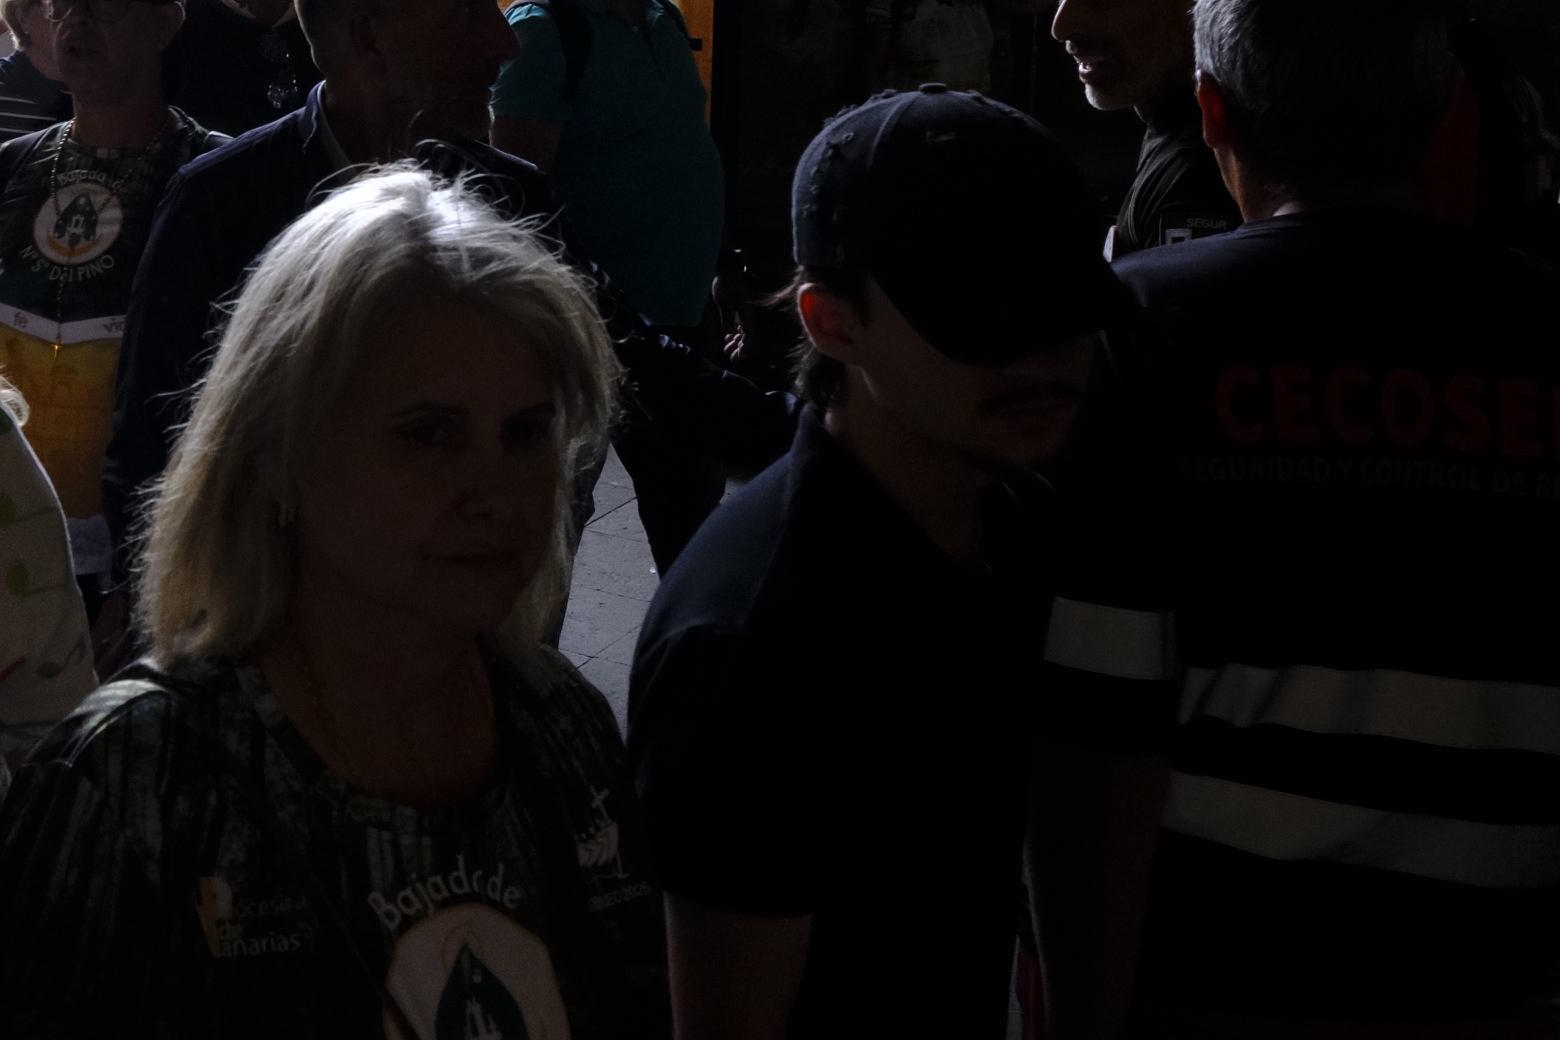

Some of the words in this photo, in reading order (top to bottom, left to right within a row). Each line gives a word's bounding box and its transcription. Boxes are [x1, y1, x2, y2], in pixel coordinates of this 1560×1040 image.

[78, 253, 116, 282] PINO
[1212, 363, 1560, 460] CECOSE
[487, 861, 524, 912] de
